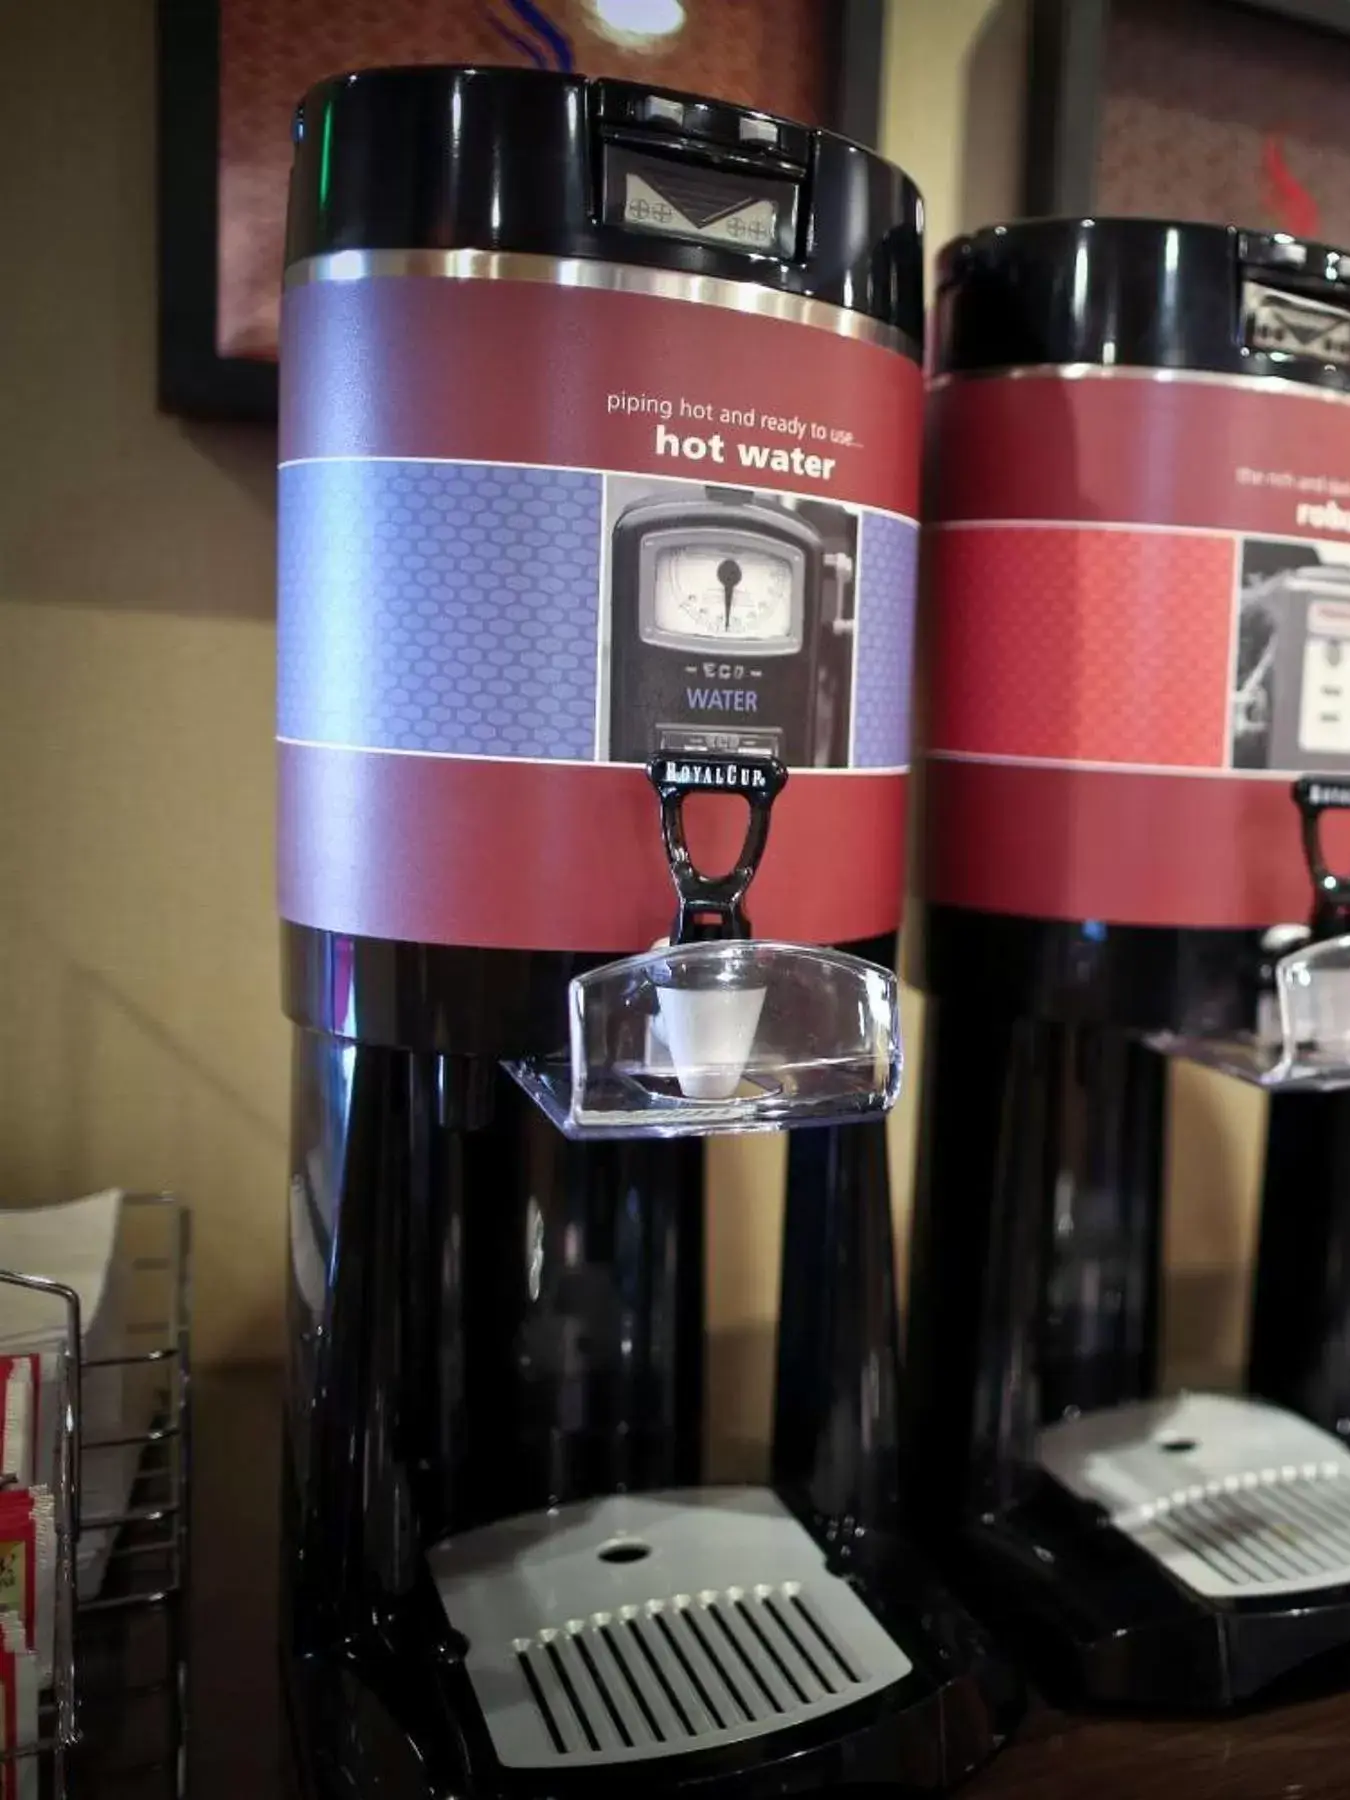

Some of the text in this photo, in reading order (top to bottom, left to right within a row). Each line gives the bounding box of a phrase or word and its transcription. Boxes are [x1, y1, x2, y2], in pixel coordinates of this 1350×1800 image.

[607, 391, 672, 419] piping
[680, 397, 713, 422] hot
[720, 408, 755, 427] and
[761, 414, 807, 440] ready
[811, 422, 827, 440] to
[655, 424, 836, 481] hot water
[686, 687, 758, 712] WATER
